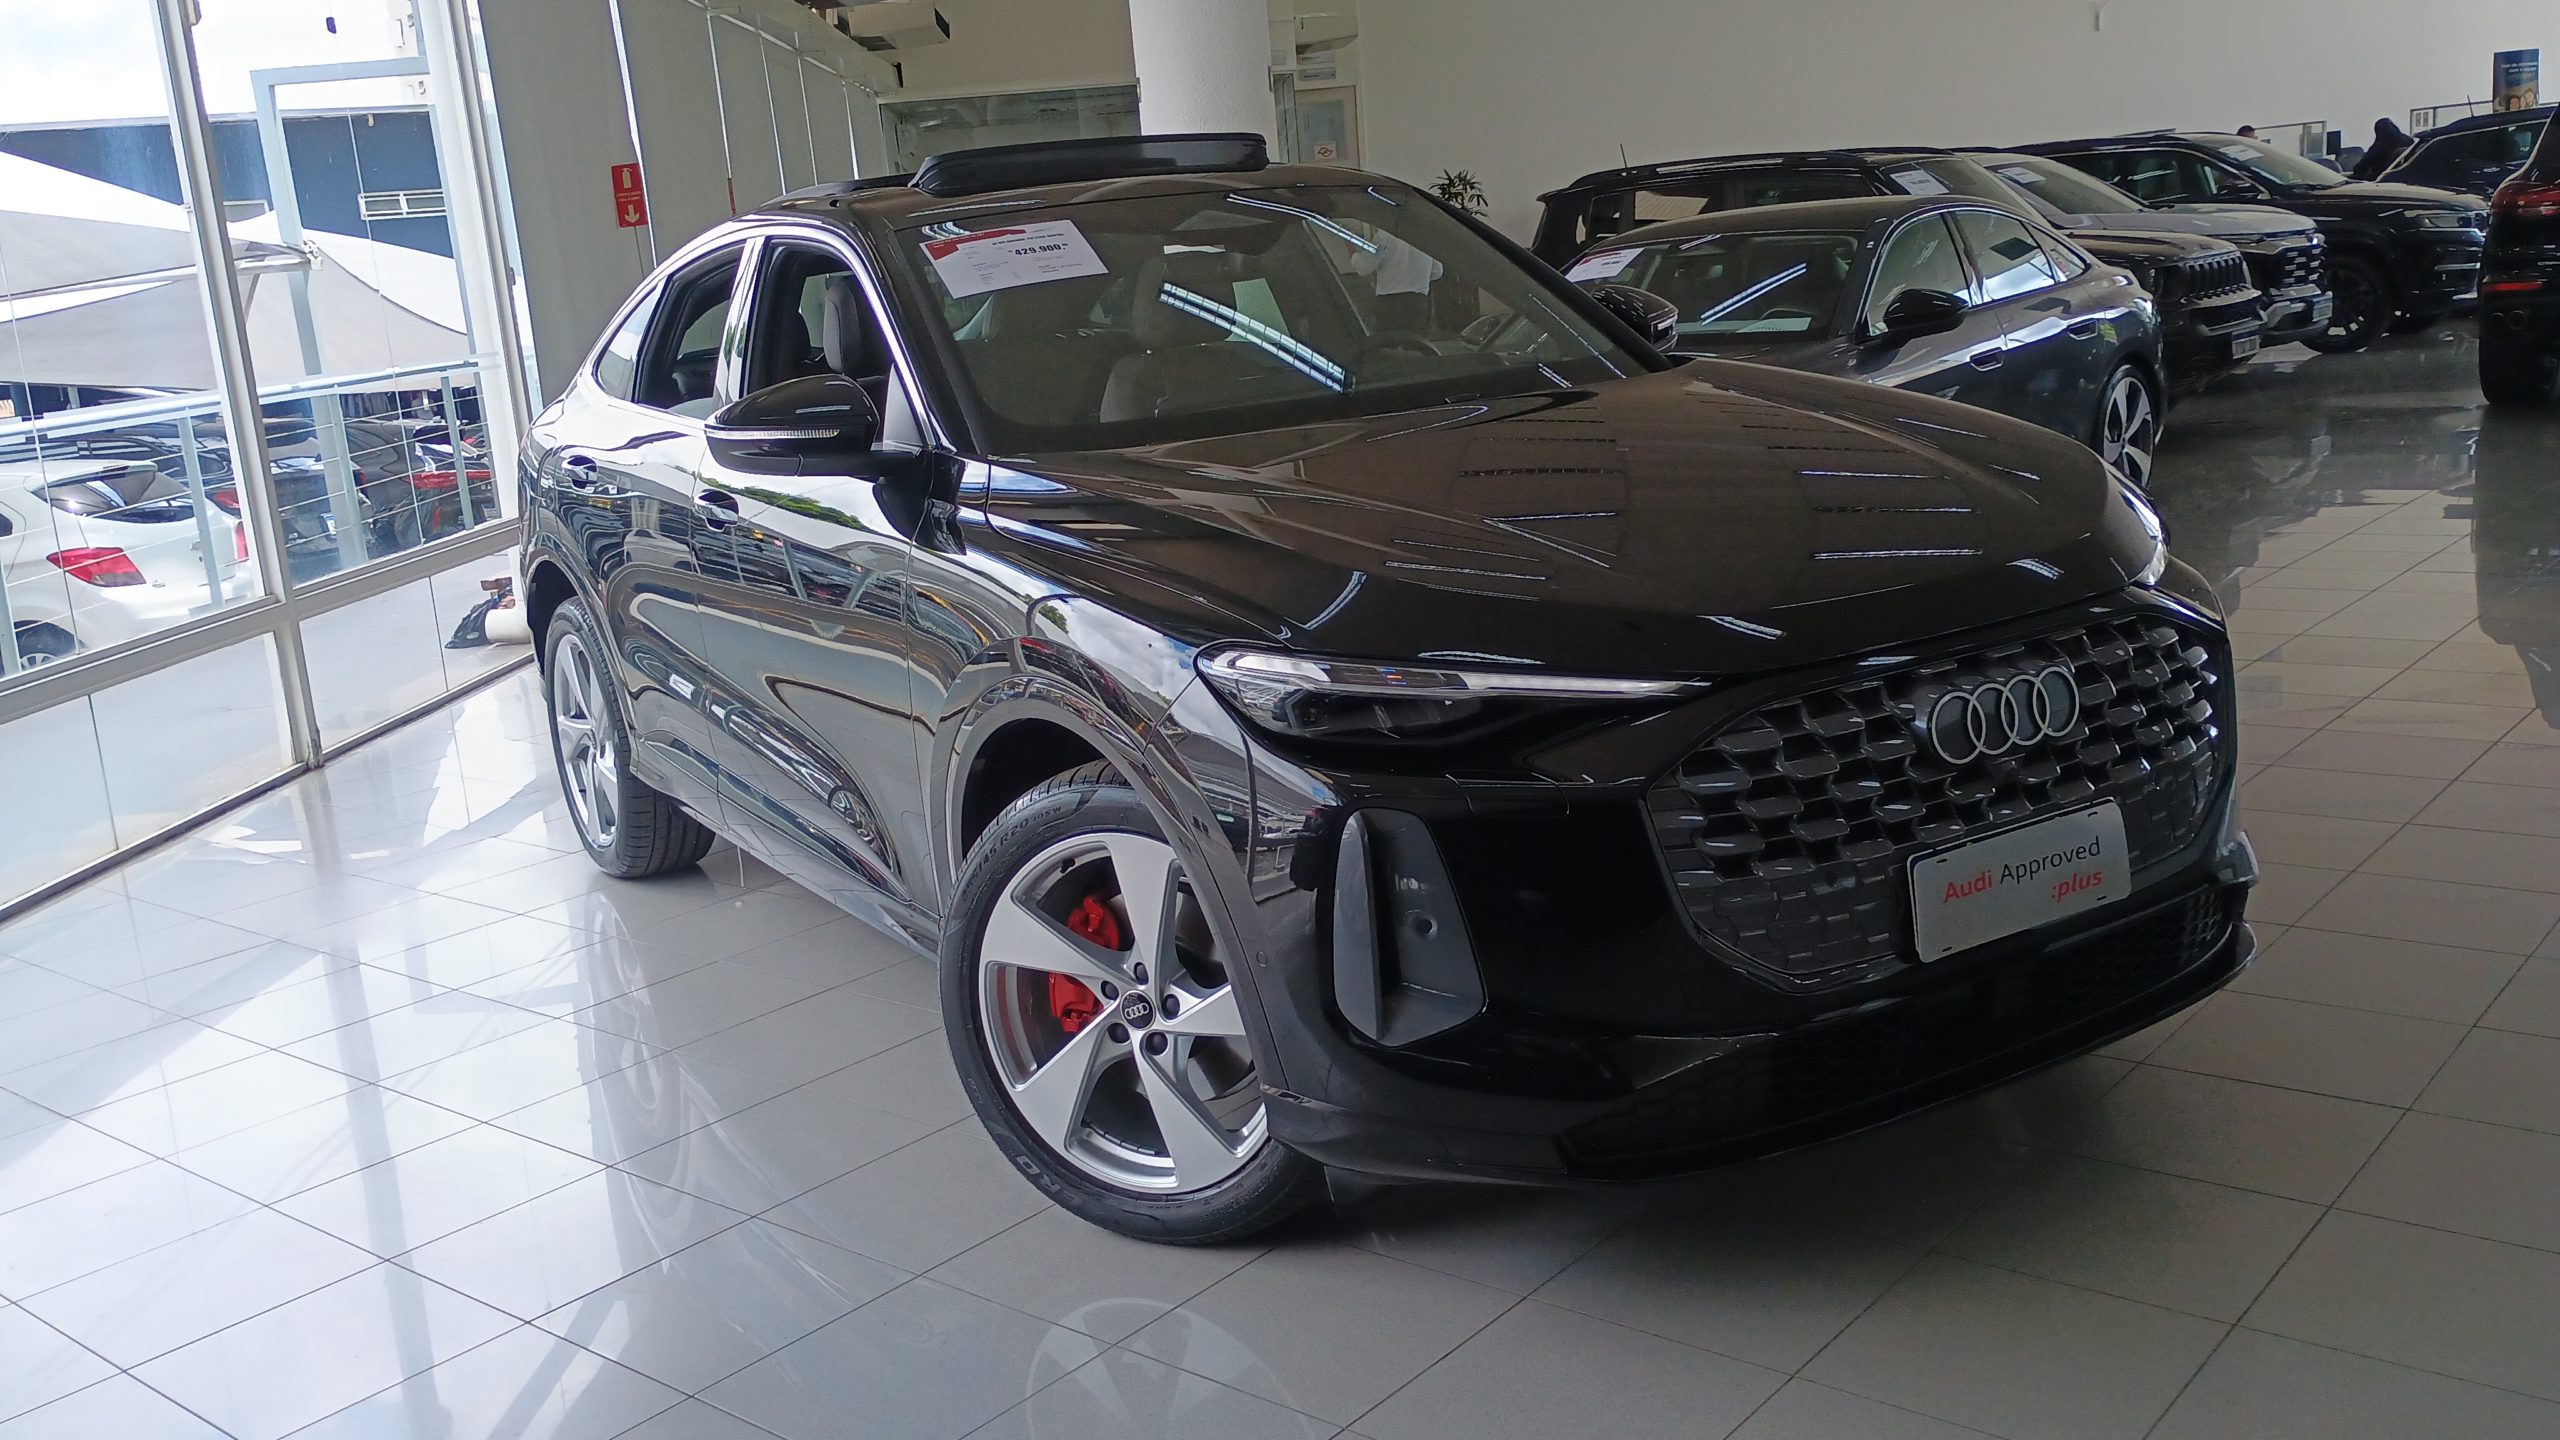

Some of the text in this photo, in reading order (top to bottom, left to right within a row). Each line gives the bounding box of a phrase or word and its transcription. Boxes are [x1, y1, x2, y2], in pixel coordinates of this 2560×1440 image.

[1943, 835, 2102, 904] Audi Approved
[2051, 871, 2103, 903] :plus
